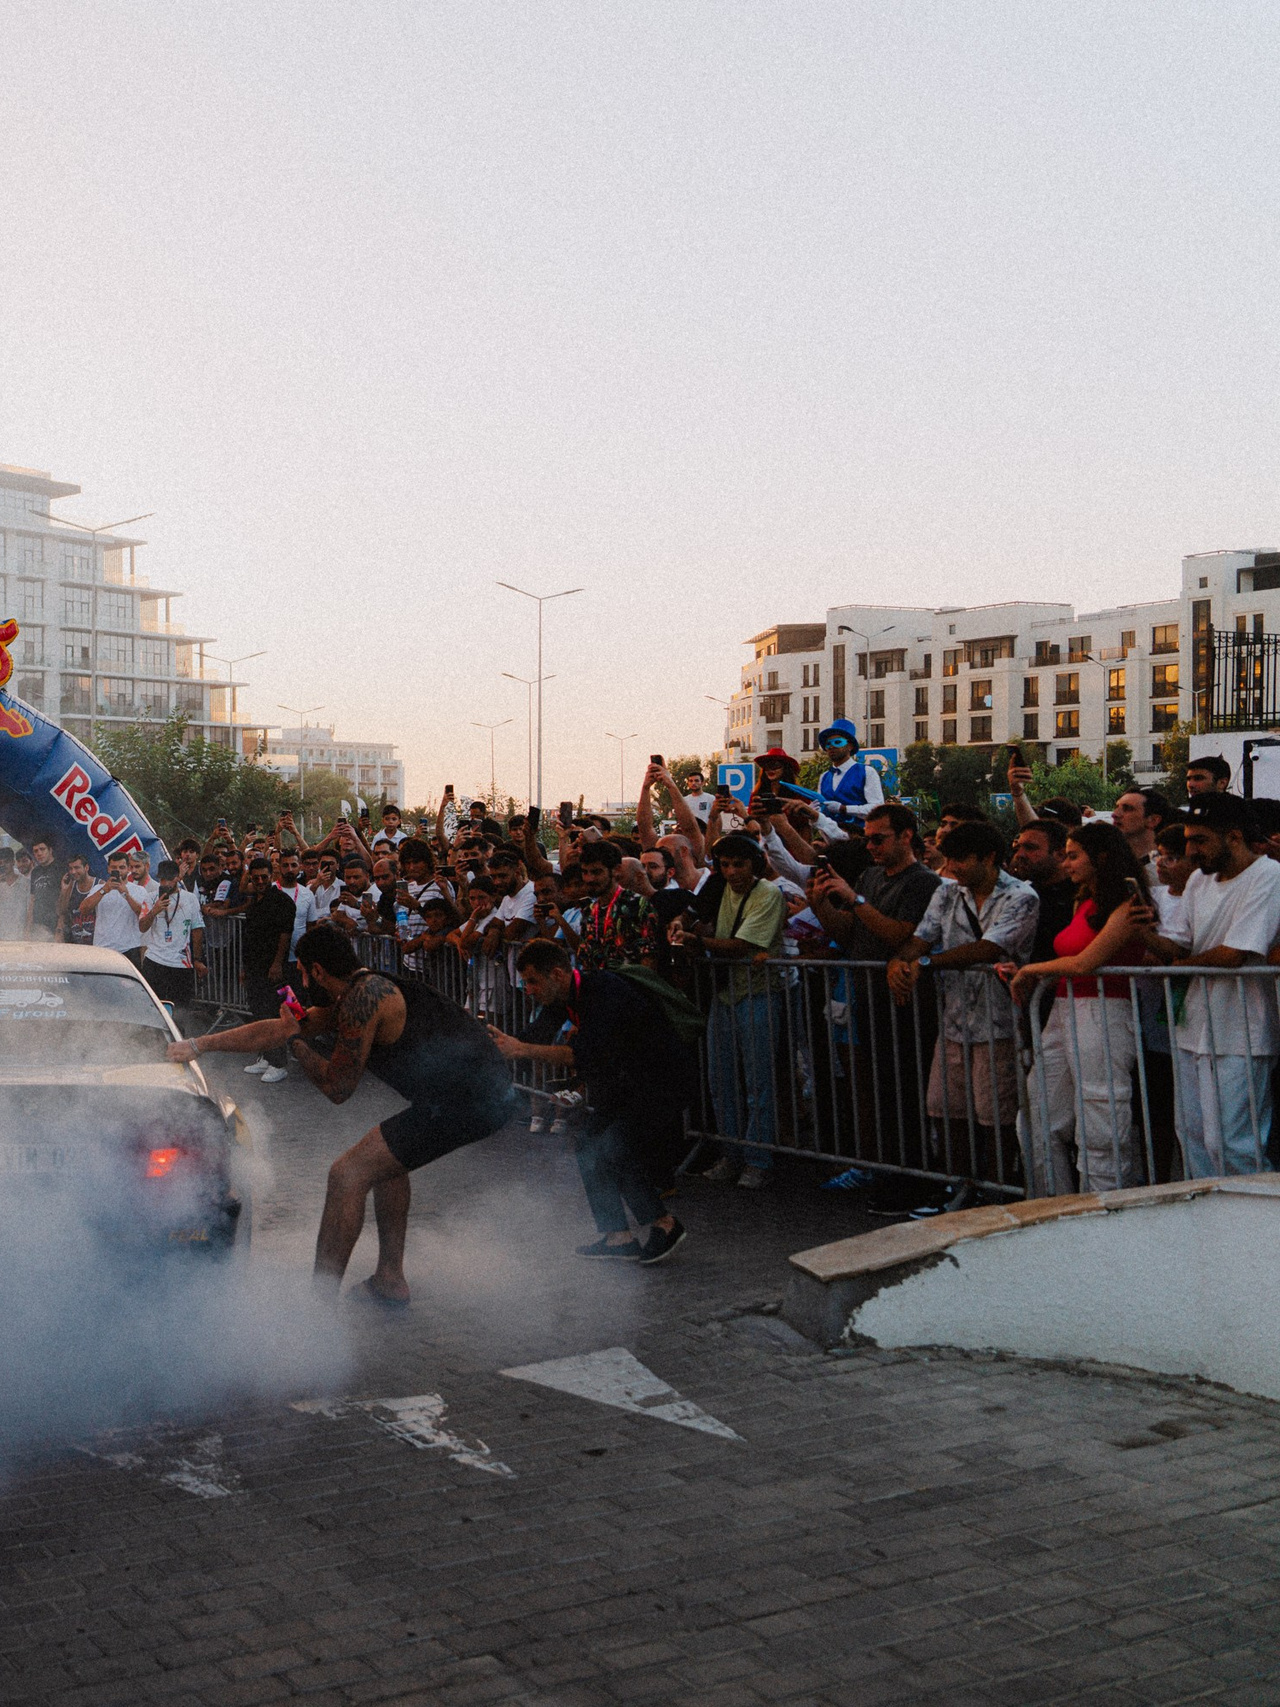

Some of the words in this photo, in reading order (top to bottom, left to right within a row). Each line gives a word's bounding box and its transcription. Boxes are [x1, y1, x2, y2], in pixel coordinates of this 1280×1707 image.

[725, 769, 746, 791] P
[51, 763, 130, 849] Red
[12, 1009, 68, 1020] group
